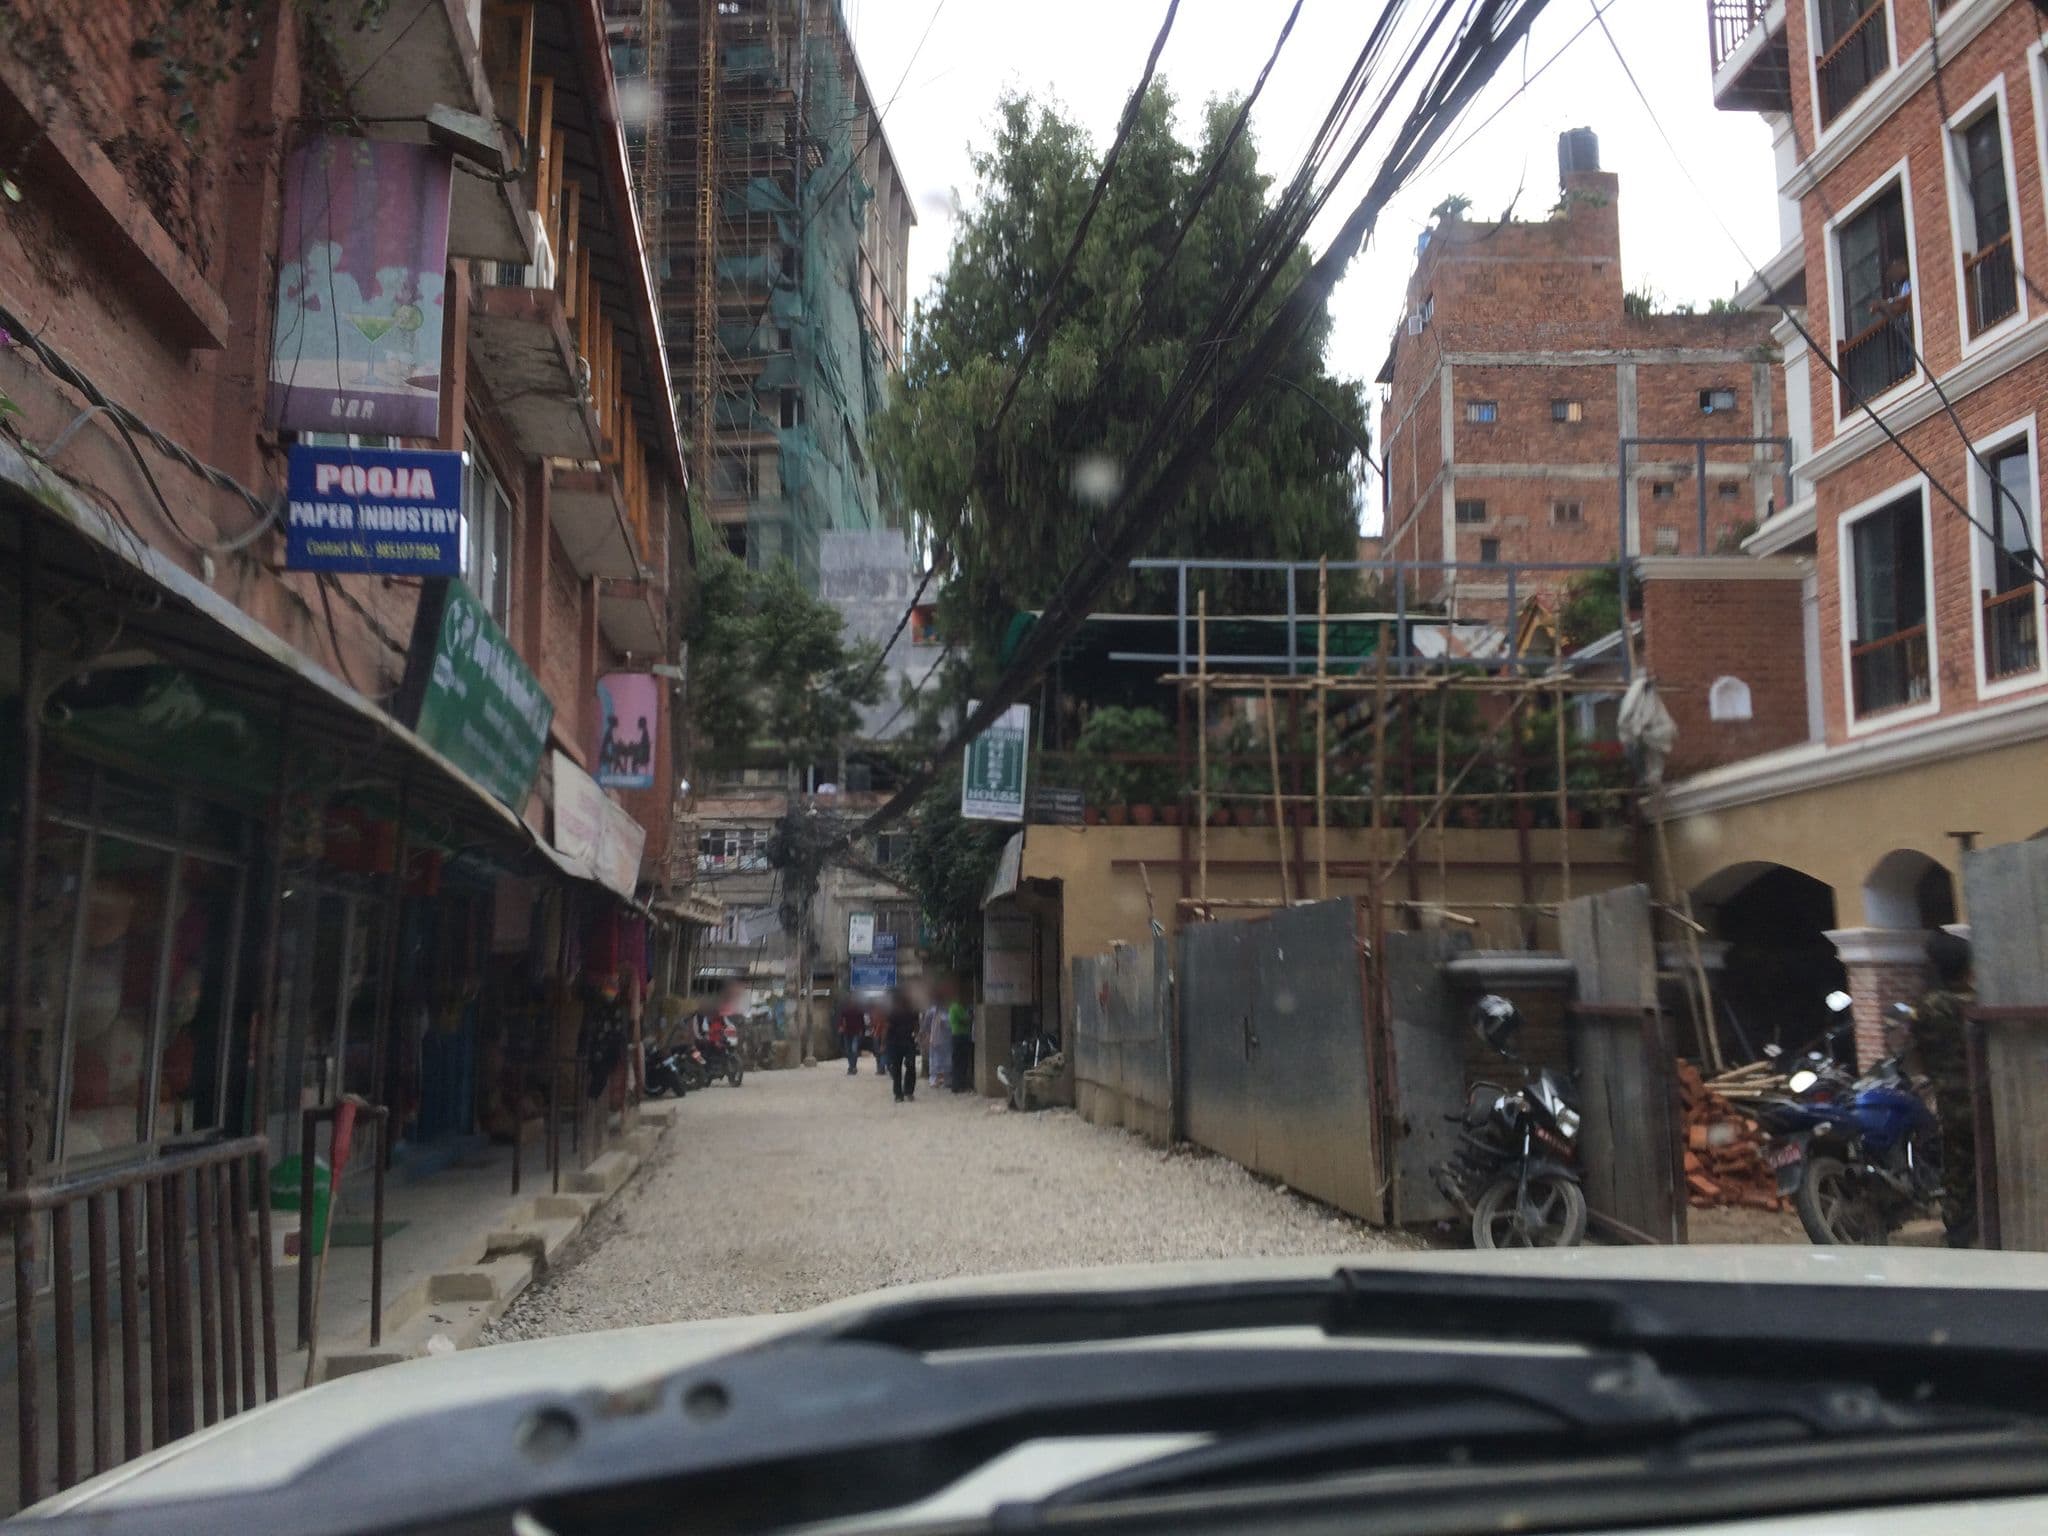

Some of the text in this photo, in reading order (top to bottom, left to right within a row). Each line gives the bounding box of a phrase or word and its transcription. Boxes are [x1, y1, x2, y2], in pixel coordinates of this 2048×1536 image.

[315, 463, 436, 500] POOJA
[289, 501, 457, 534] PAPER INDUSTRY
[967, 788, 1021, 803] HOUSE
